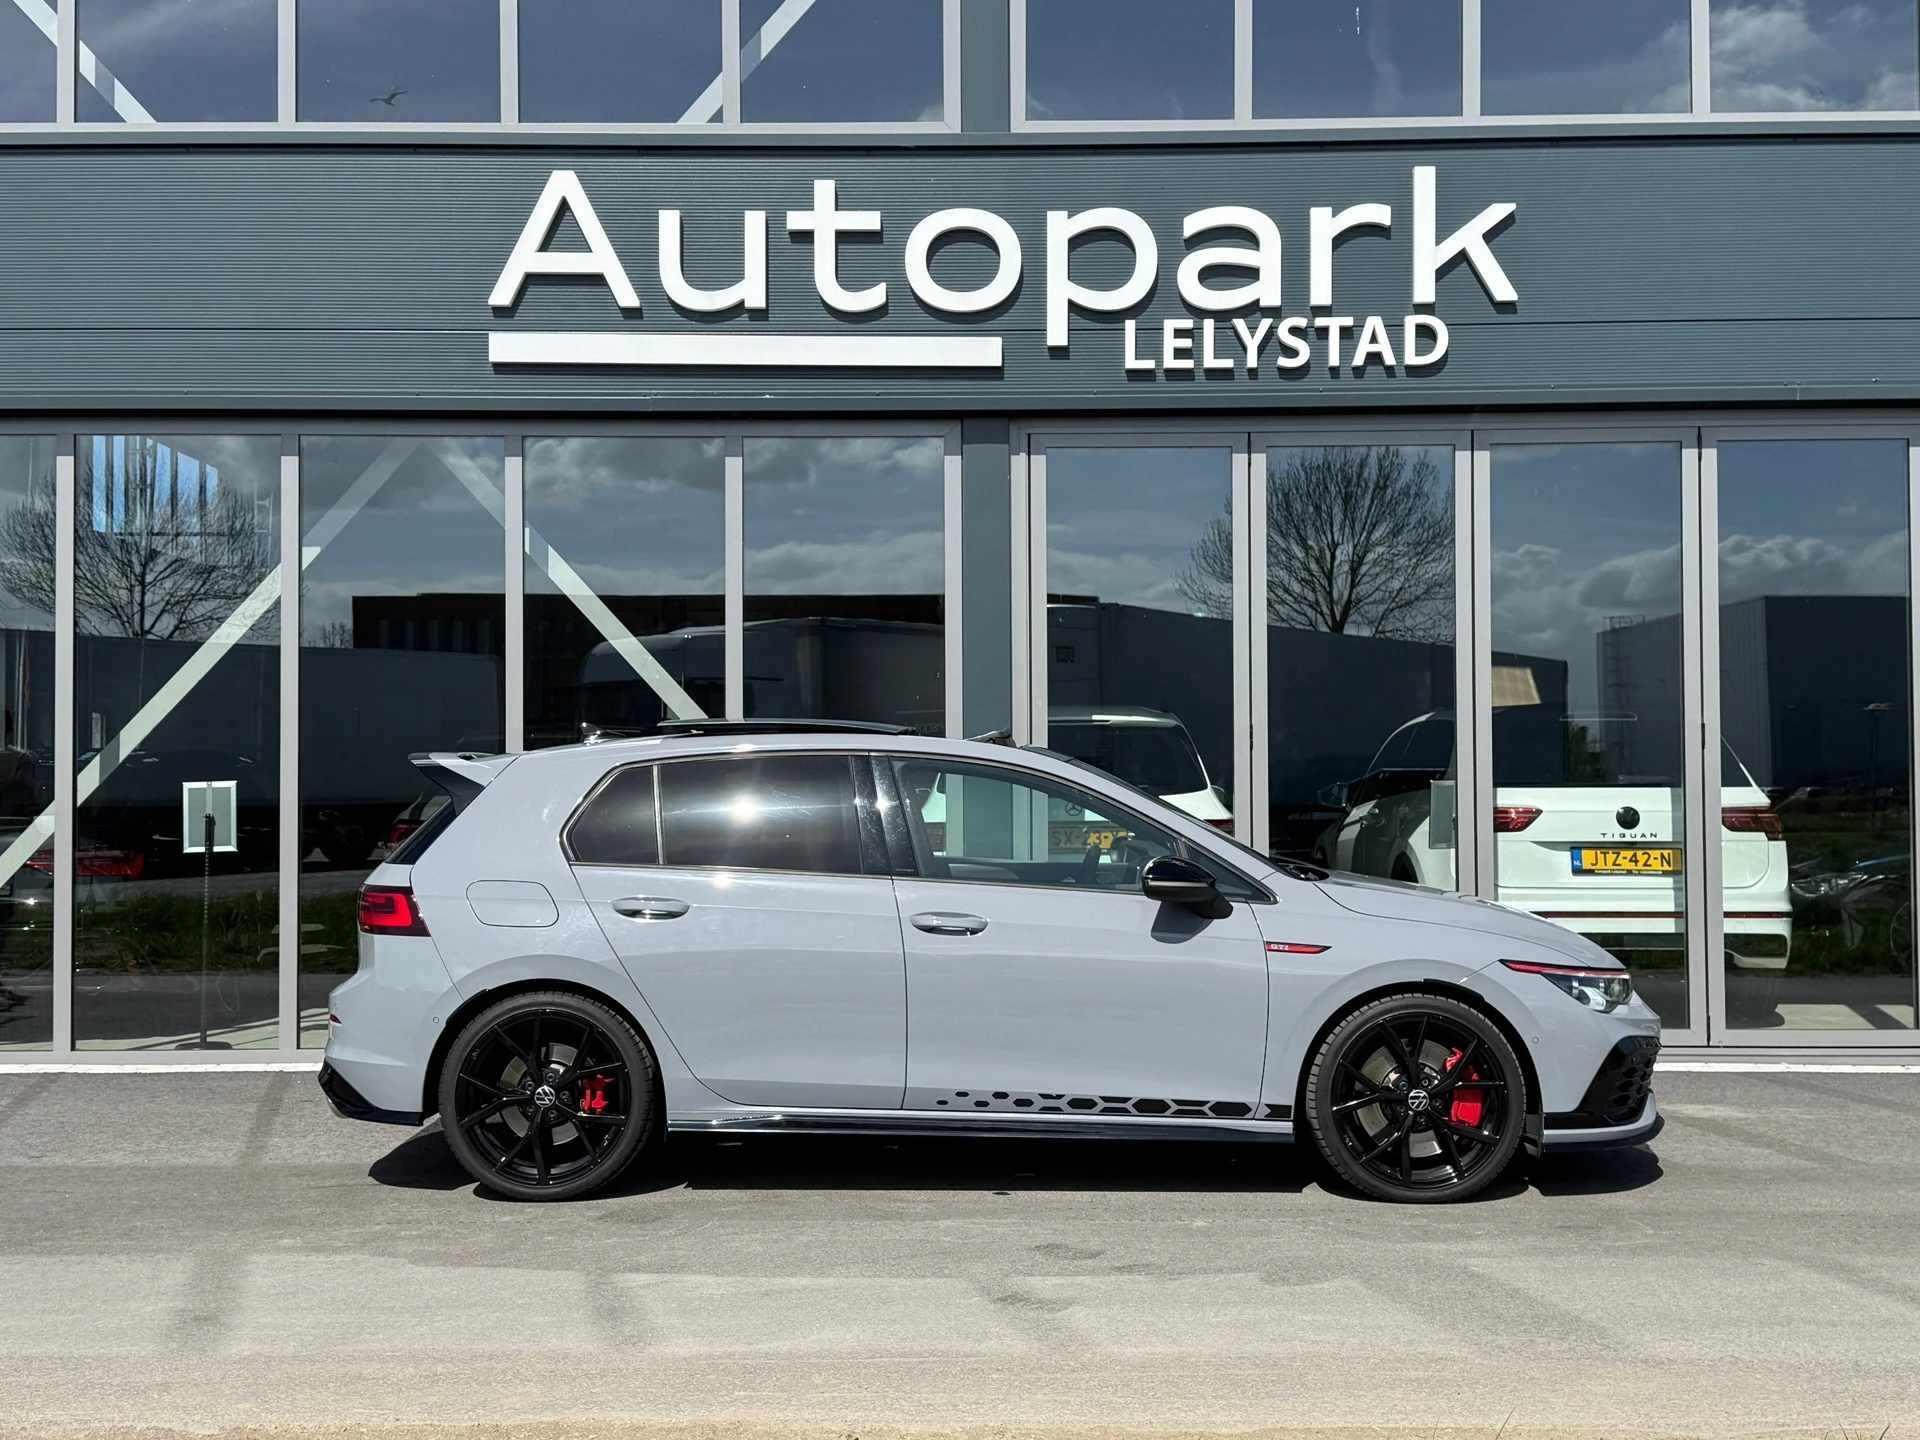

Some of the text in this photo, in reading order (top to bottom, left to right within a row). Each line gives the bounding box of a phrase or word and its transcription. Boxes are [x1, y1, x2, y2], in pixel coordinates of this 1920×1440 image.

[487, 166, 1519, 347] Autopark
[1124, 314, 1450, 371] LELYSTAD
[1591, 851, 1672, 867] JTZ-42-N
[1270, 943, 1290, 951] GTI
